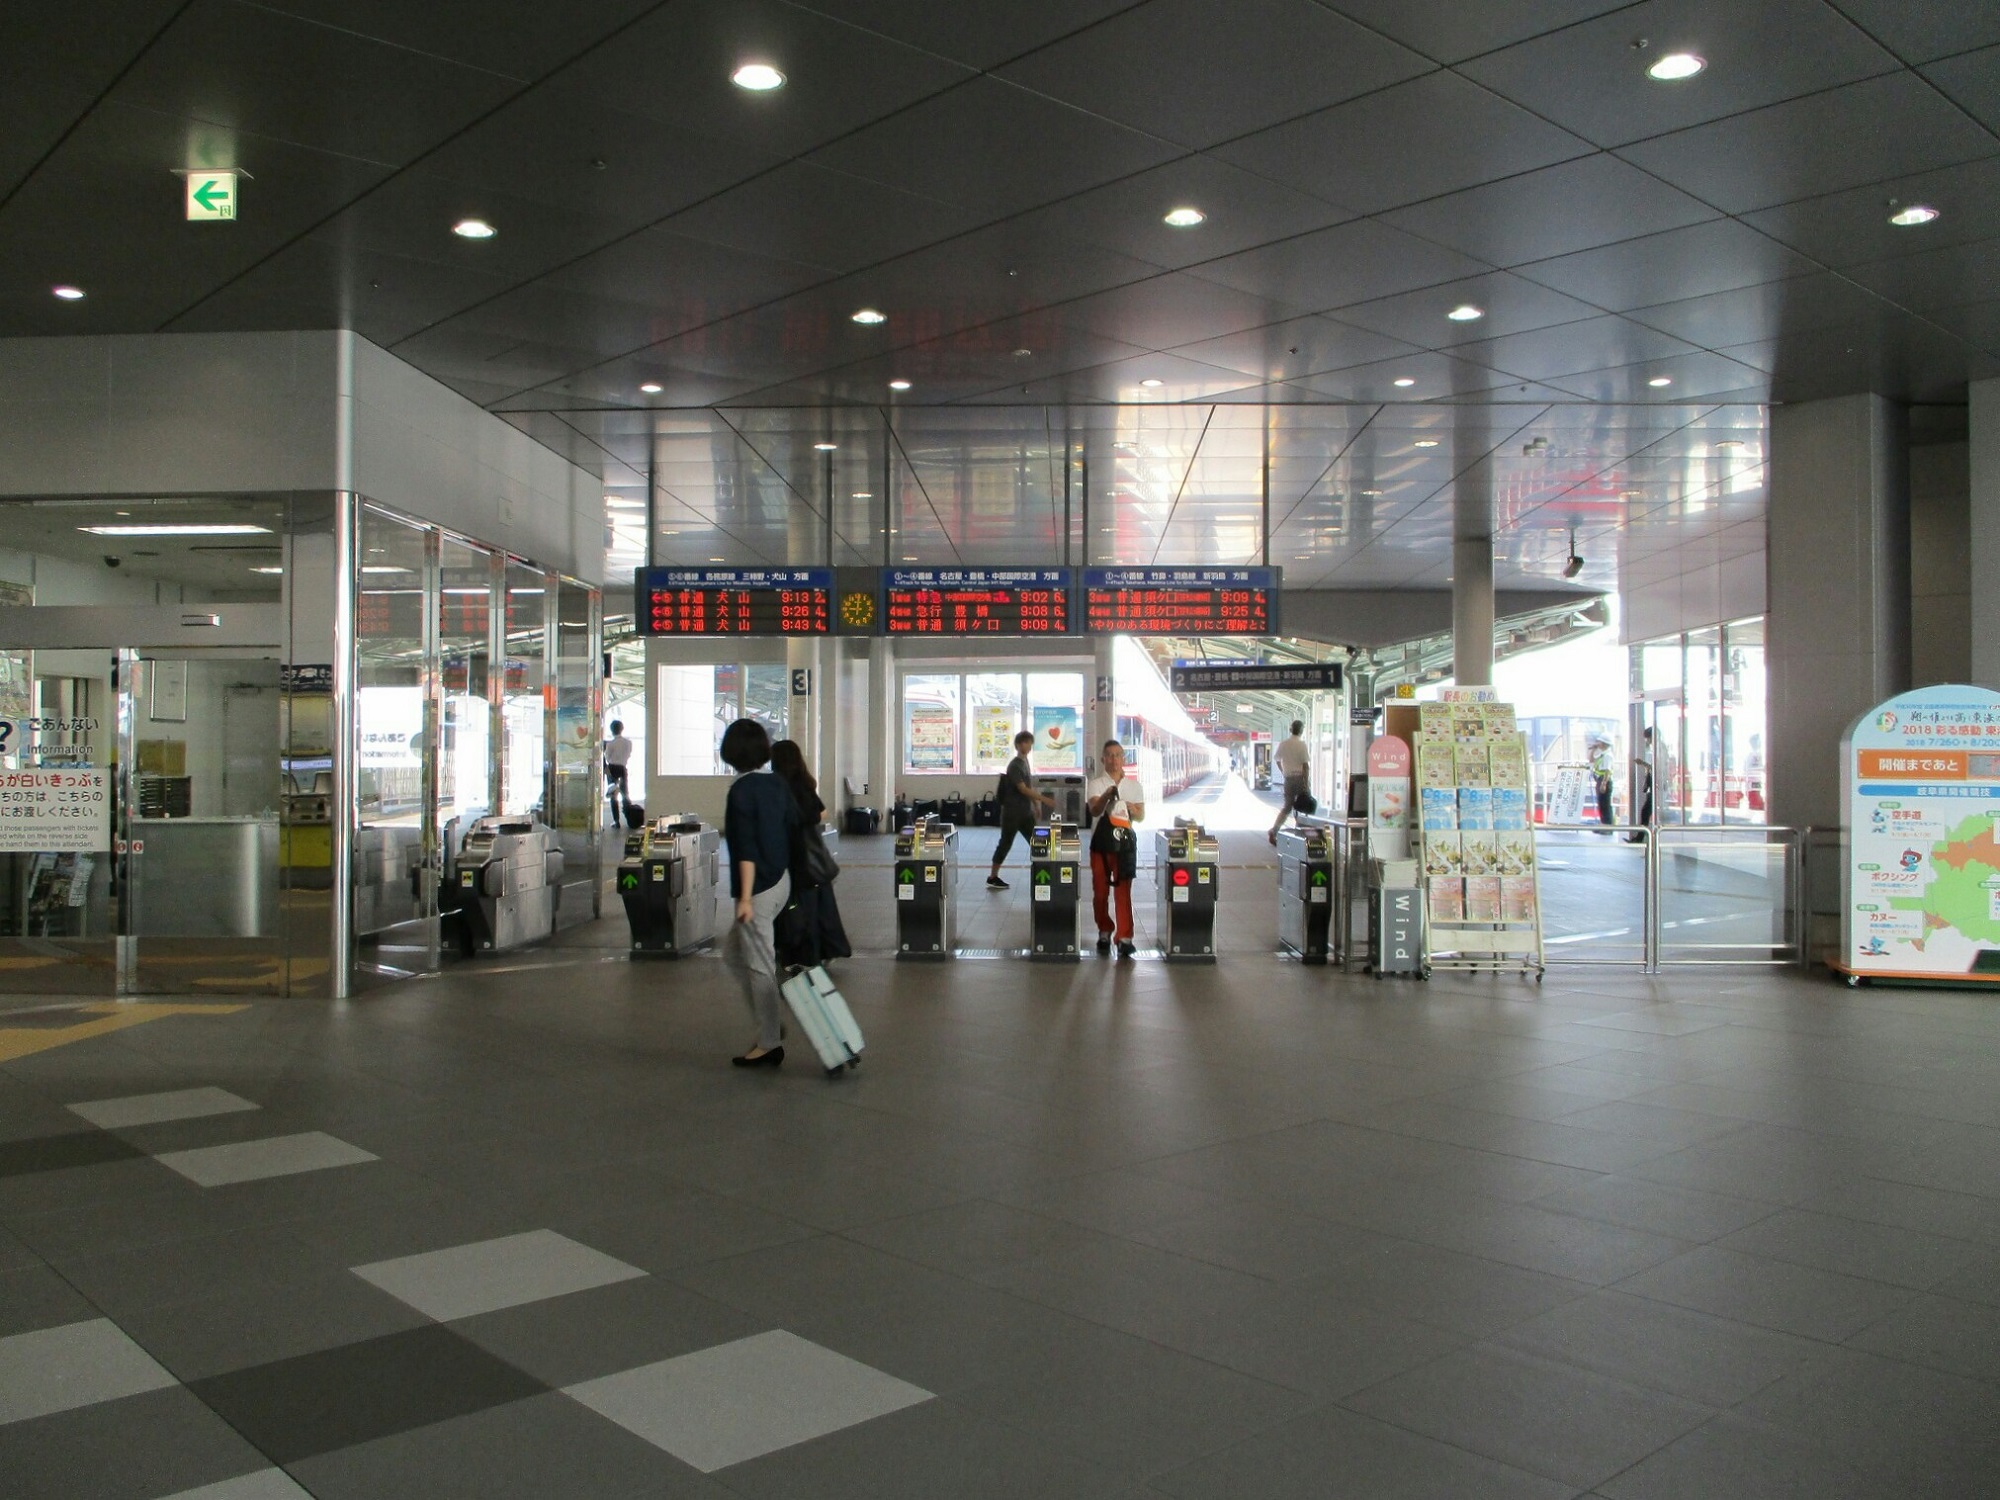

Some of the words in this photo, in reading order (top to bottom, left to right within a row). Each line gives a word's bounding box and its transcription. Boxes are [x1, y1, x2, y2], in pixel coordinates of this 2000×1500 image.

[1044, 572, 1059, 581] 方面
[1233, 572, 1248, 581] 方面
[781, 592, 809, 603] 9:13
[1021, 592, 1048, 603] 9:02
[1221, 592, 1249, 603] 9:09
[781, 605, 809, 616] 9:26
[1021, 605, 1048, 616] 9:08
[1221, 605, 1249, 616] 9:25
[781, 619, 809, 630] 9:43
[1021, 619, 1048, 630] 9:09
[795, 672, 806, 691] 3
[1176, 673, 1186, 687] 2
[1328, 671, 1335, 683] 1
[1210, 711, 1218, 721] 2
[1903, 725, 1932, 735] 2018
[27, 744, 94, 754] Information
[1372, 752, 1407, 761] Wind
[1879, 758, 1958, 771] 開催まであと
[2, 791, 103, 802] ちの方は、こちらの
[1, 807, 99, 818] にお渡しください。
[1892, 811, 1921, 820] 空手道
[1871, 873, 1919, 882] ボクシング
[1870, 913, 1897, 922] カヌー
[1395, 895, 1410, 959] Wind
